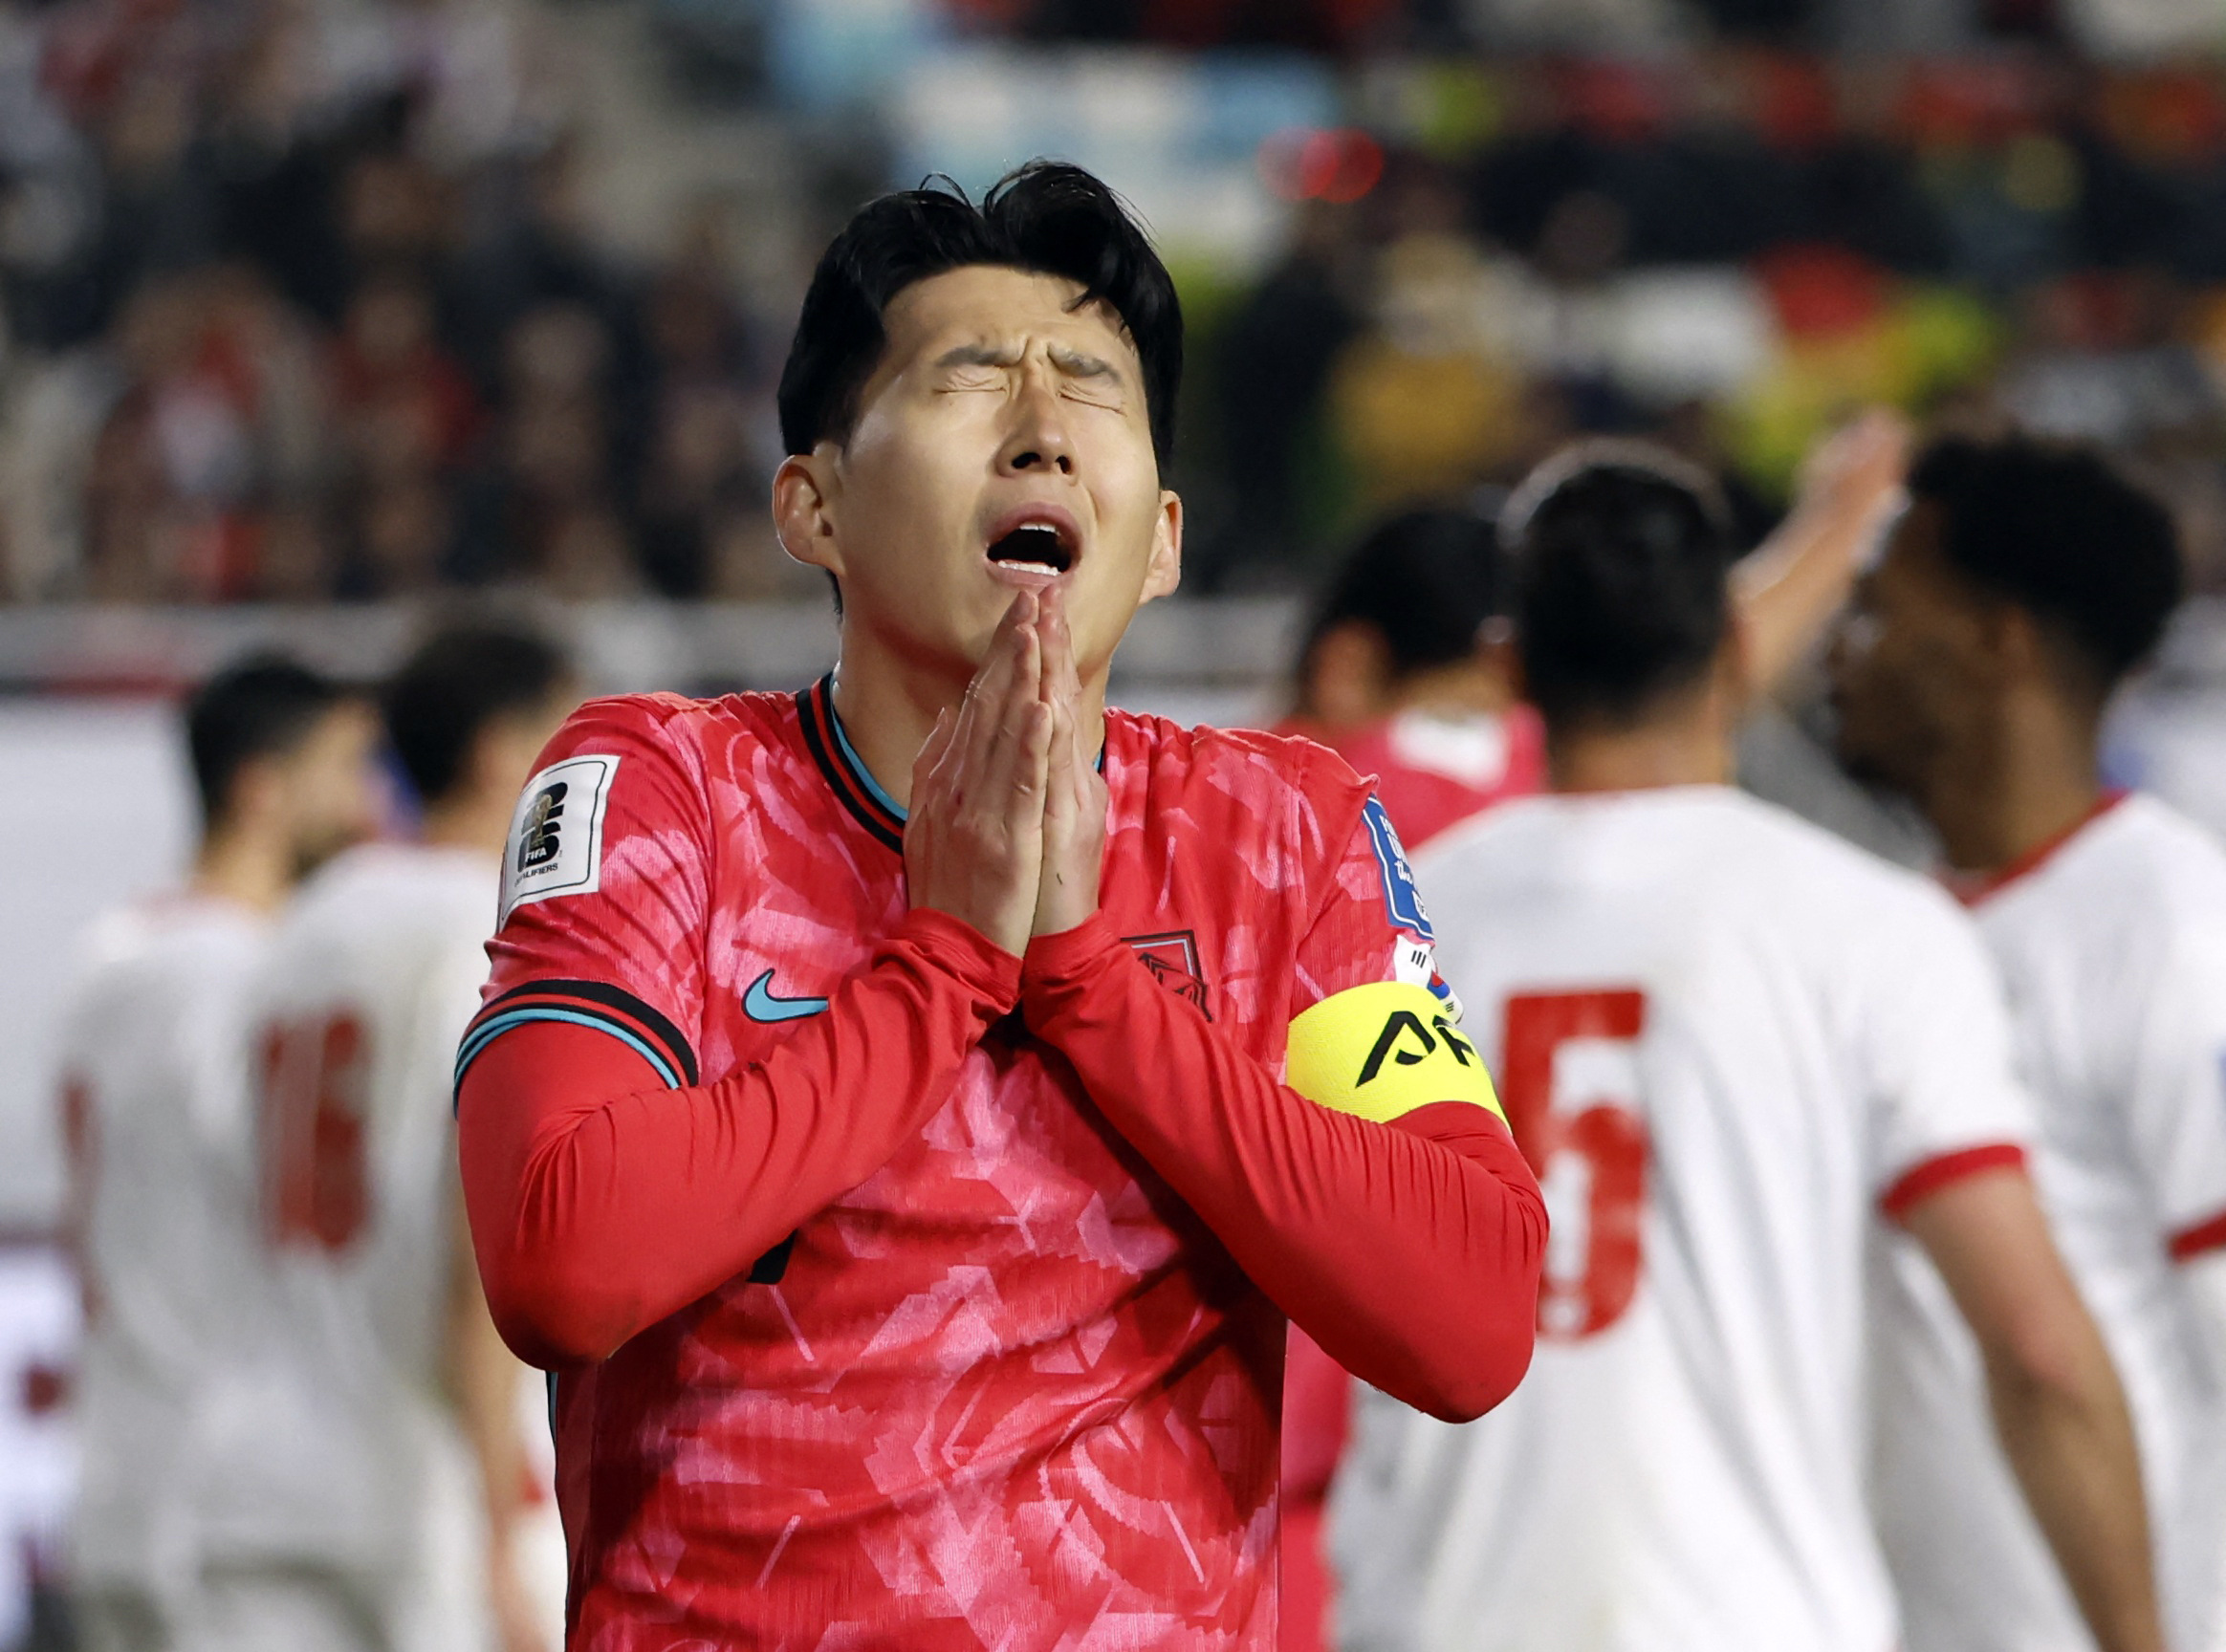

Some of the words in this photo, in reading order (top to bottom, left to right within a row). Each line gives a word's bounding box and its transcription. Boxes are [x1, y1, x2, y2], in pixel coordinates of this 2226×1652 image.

[525, 847, 547, 863] FIFA
[514, 862, 559, 887] ALIFIERS
[1502, 989, 1647, 1341] 5
